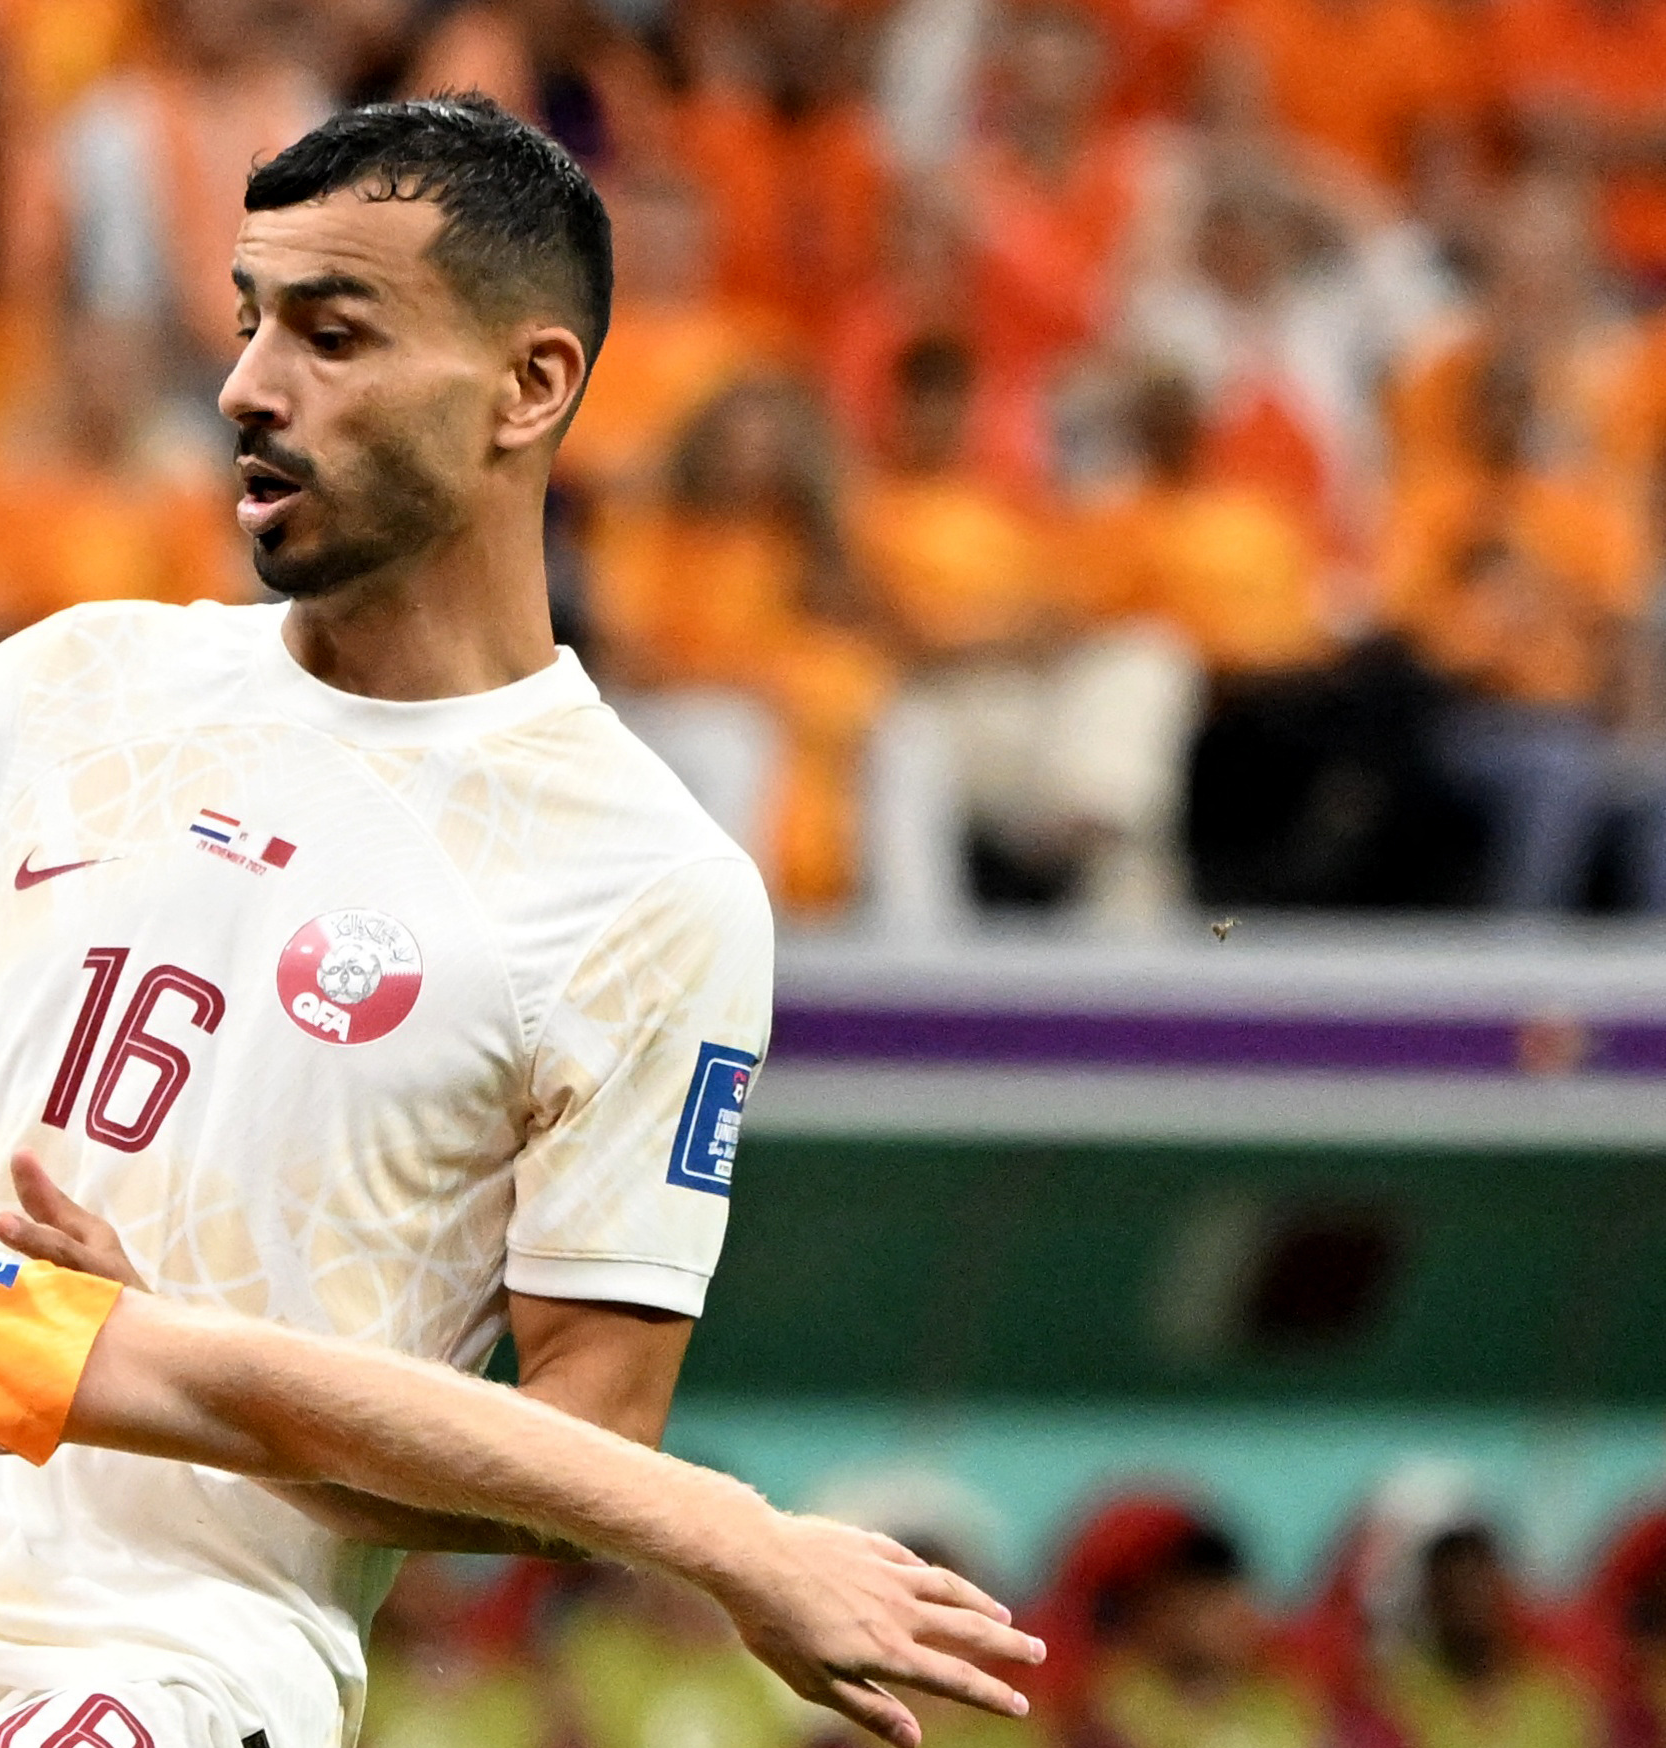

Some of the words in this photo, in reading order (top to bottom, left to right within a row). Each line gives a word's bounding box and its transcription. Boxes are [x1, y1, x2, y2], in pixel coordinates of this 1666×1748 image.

[208, 844, 246, 865] NOVEMBER
[291, 991, 352, 1043] QFA
[40, 947, 226, 1154] 16
